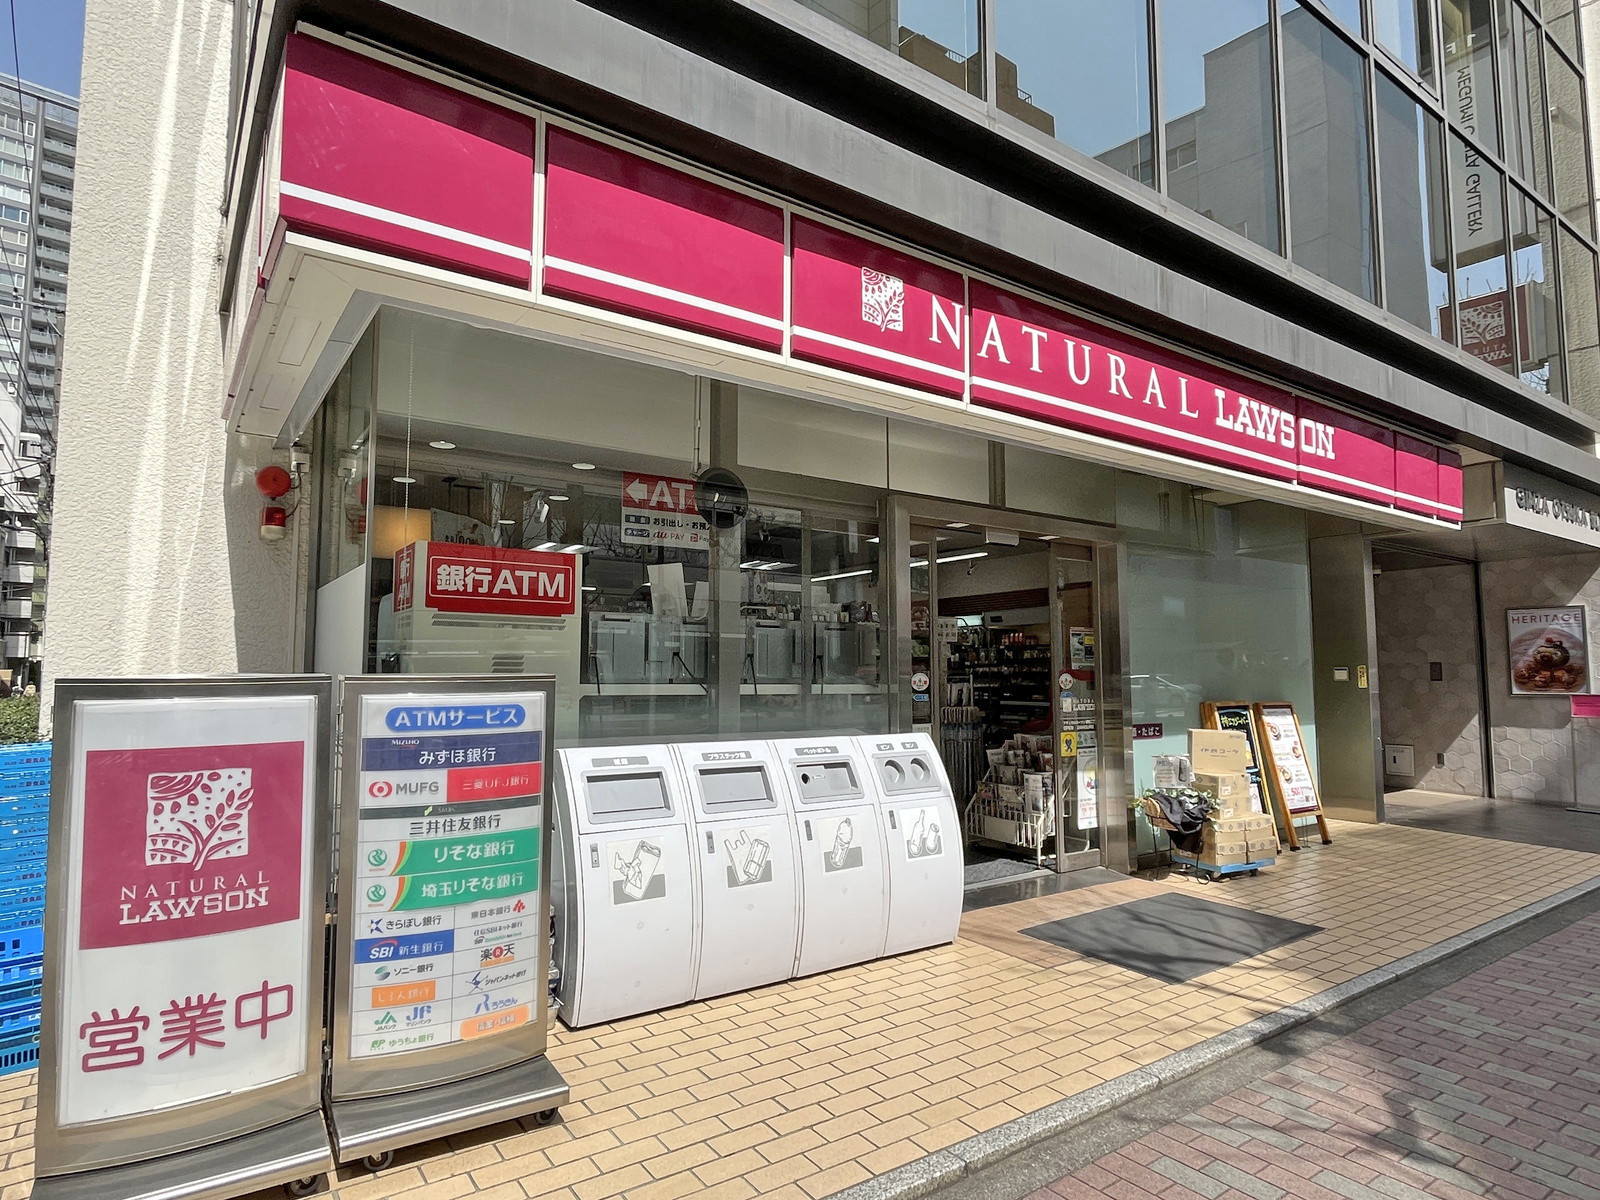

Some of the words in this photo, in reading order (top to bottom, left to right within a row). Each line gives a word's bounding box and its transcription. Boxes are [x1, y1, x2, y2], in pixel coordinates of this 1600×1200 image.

[929, 295, 1199, 419] NATURAL
[1215, 387, 1336, 460] LAWSON
[649, 480, 699, 512] AT
[1516, 487, 1550, 517] GINZA
[671, 533, 685, 541] PAY
[437, 564, 565, 598] 銀行ATM
[1511, 613, 1581, 625] HERITAGE
[394, 708, 518, 727] ATMサービス
[392, 738, 420, 746] MIZUHO
[419, 748, 497, 765] みずほ銀行
[396, 781, 440, 796] MUFG
[462, 775, 529, 791] 三菱UFJ銀行
[410, 814, 502, 836] 三井住友銀行
[434, 841, 515, 863] りそな銀行
[120, 870, 270, 901] NATURAL
[422, 872, 524, 898] 埼玉りそな銀行
[119, 888, 269, 925] LAWSON
[471, 905, 511, 920] 東日本銀行
[386, 915, 442, 930] きらぼし銀行
[369, 946, 394, 959] SBI
[399, 941, 444, 956] 新生銀行
[394, 963, 434, 976] ソニー銀行
[484, 969, 526, 986] ジャパンネット銀行
[492, 997, 519, 1010] ろうきん
[80, 980, 293, 1073] 営業中
[389, 1033, 435, 1048] ゆうちょ銀行
